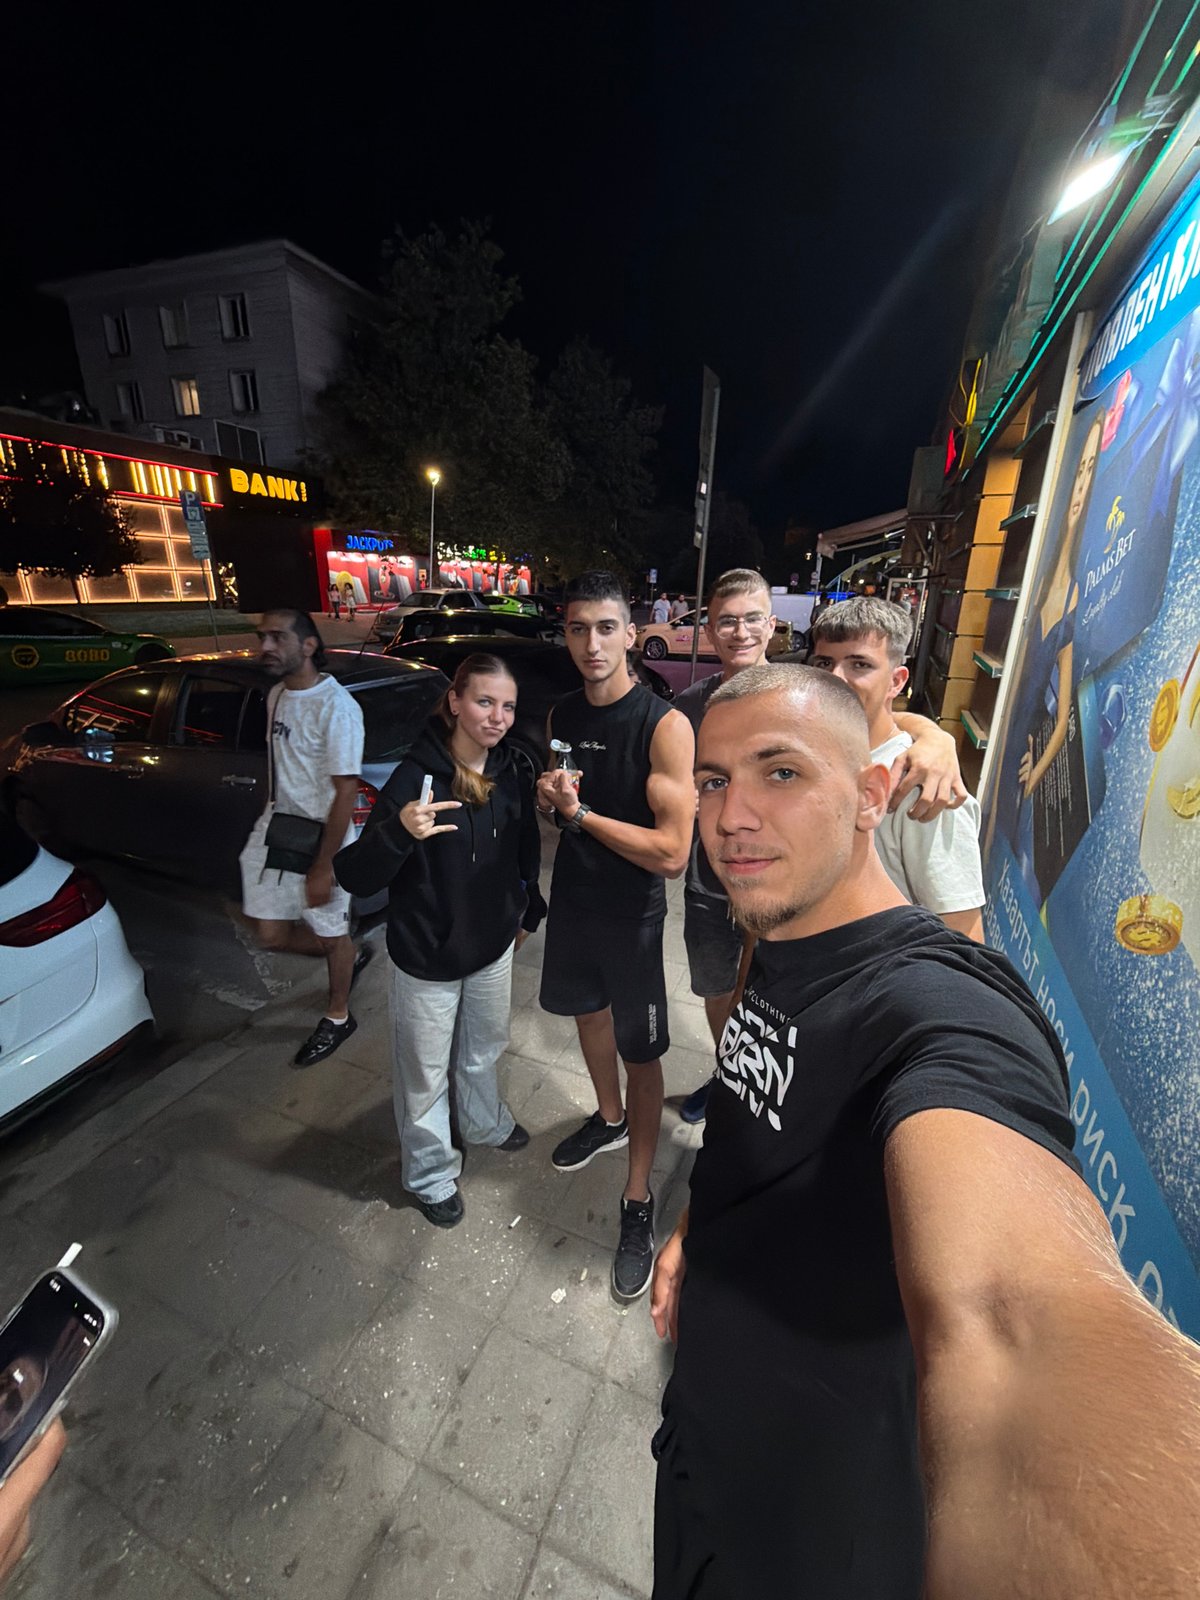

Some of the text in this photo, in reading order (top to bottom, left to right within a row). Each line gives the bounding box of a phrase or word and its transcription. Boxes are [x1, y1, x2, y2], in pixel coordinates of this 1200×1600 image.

[230, 468, 299, 501] BANK
[1084, 528, 1137, 598] PALMS BET
[1069, 1077, 1136, 1252] риск
